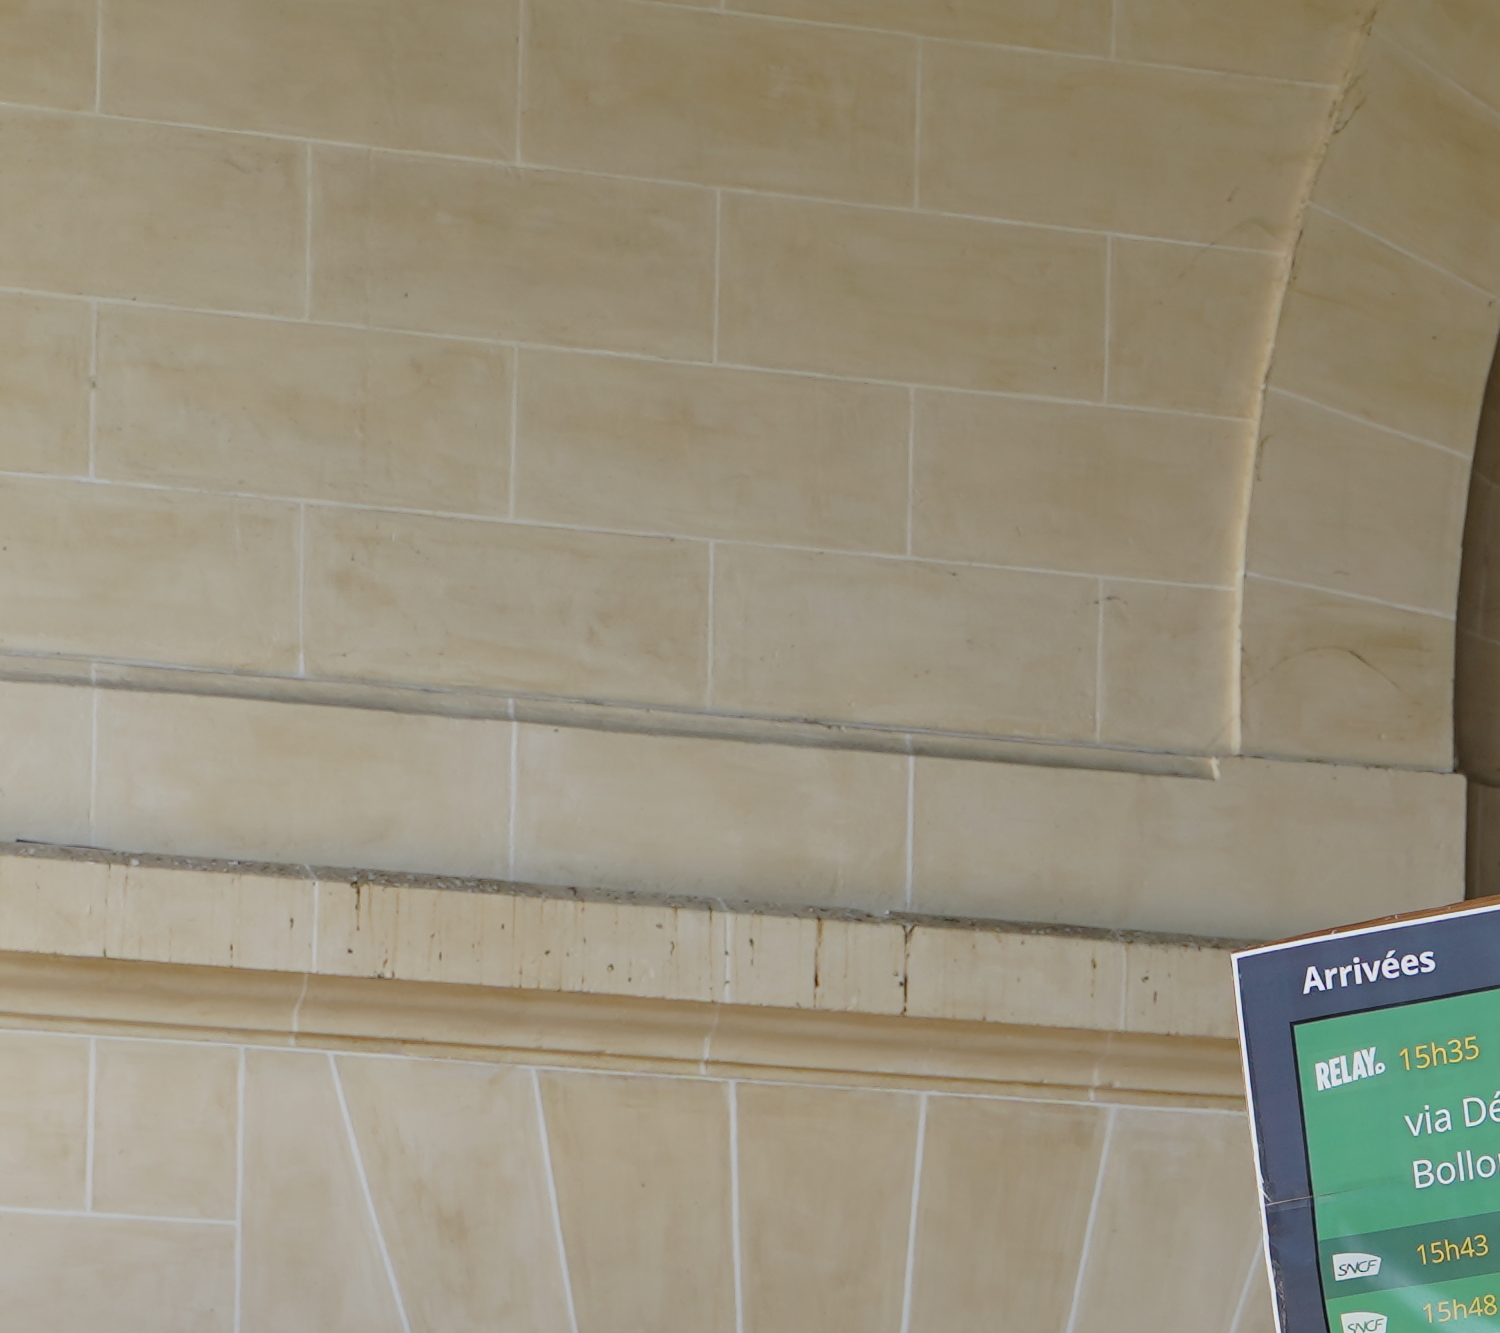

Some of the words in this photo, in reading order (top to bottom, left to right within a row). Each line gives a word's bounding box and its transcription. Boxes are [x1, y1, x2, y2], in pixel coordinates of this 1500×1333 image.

[1303, 950, 1436, 994] Arrivées
[1399, 1036, 1480, 1071] 15h35
[1404, 1103, 1452, 1138] via
[1337, 1259, 1378, 1278] SNCF
[1416, 1234, 1490, 1266] 15h43
[1423, 1294, 1498, 1324] 15h48
